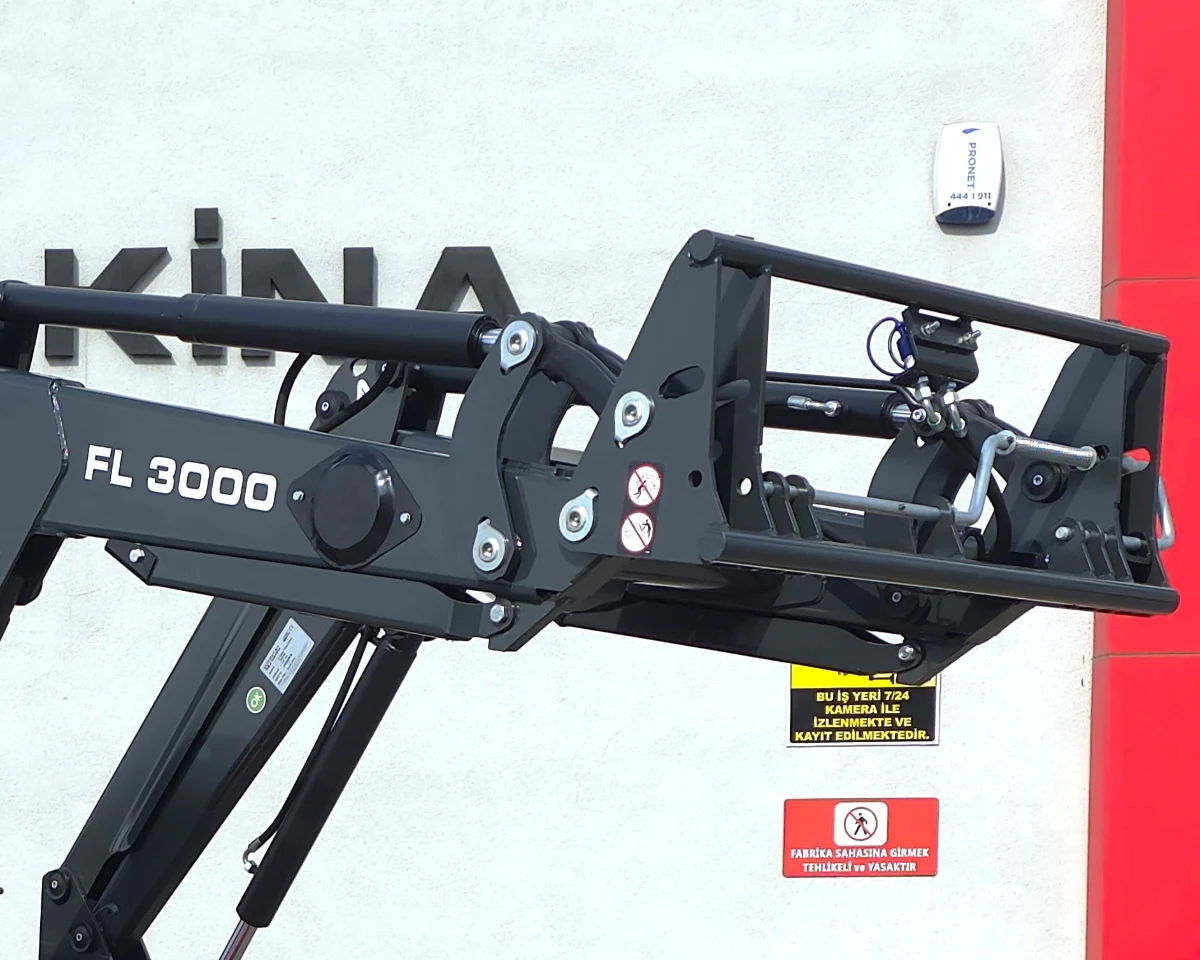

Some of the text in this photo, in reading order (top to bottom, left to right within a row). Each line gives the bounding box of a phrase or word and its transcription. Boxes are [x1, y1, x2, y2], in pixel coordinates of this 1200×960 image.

[966, 142, 977, 189] PRONET
[950, 192, 968, 200] 444
[84, 444, 277, 512] FL 3000
[816, 689, 910, 703] BU İŞ YERİ 7/24
[825, 702, 900, 714] KAMERA İLE
[814, 716, 912, 728] İZLENMEKTE VE
[795, 728, 929, 741] KAYIT EDİLMEKTEDİR.
[790, 846, 929, 858] FABRİKA SAHASINA GİRMEK
[803, 861, 852, 872] TEHLİKELİ
[868, 862, 916, 872] YASAKTIR
